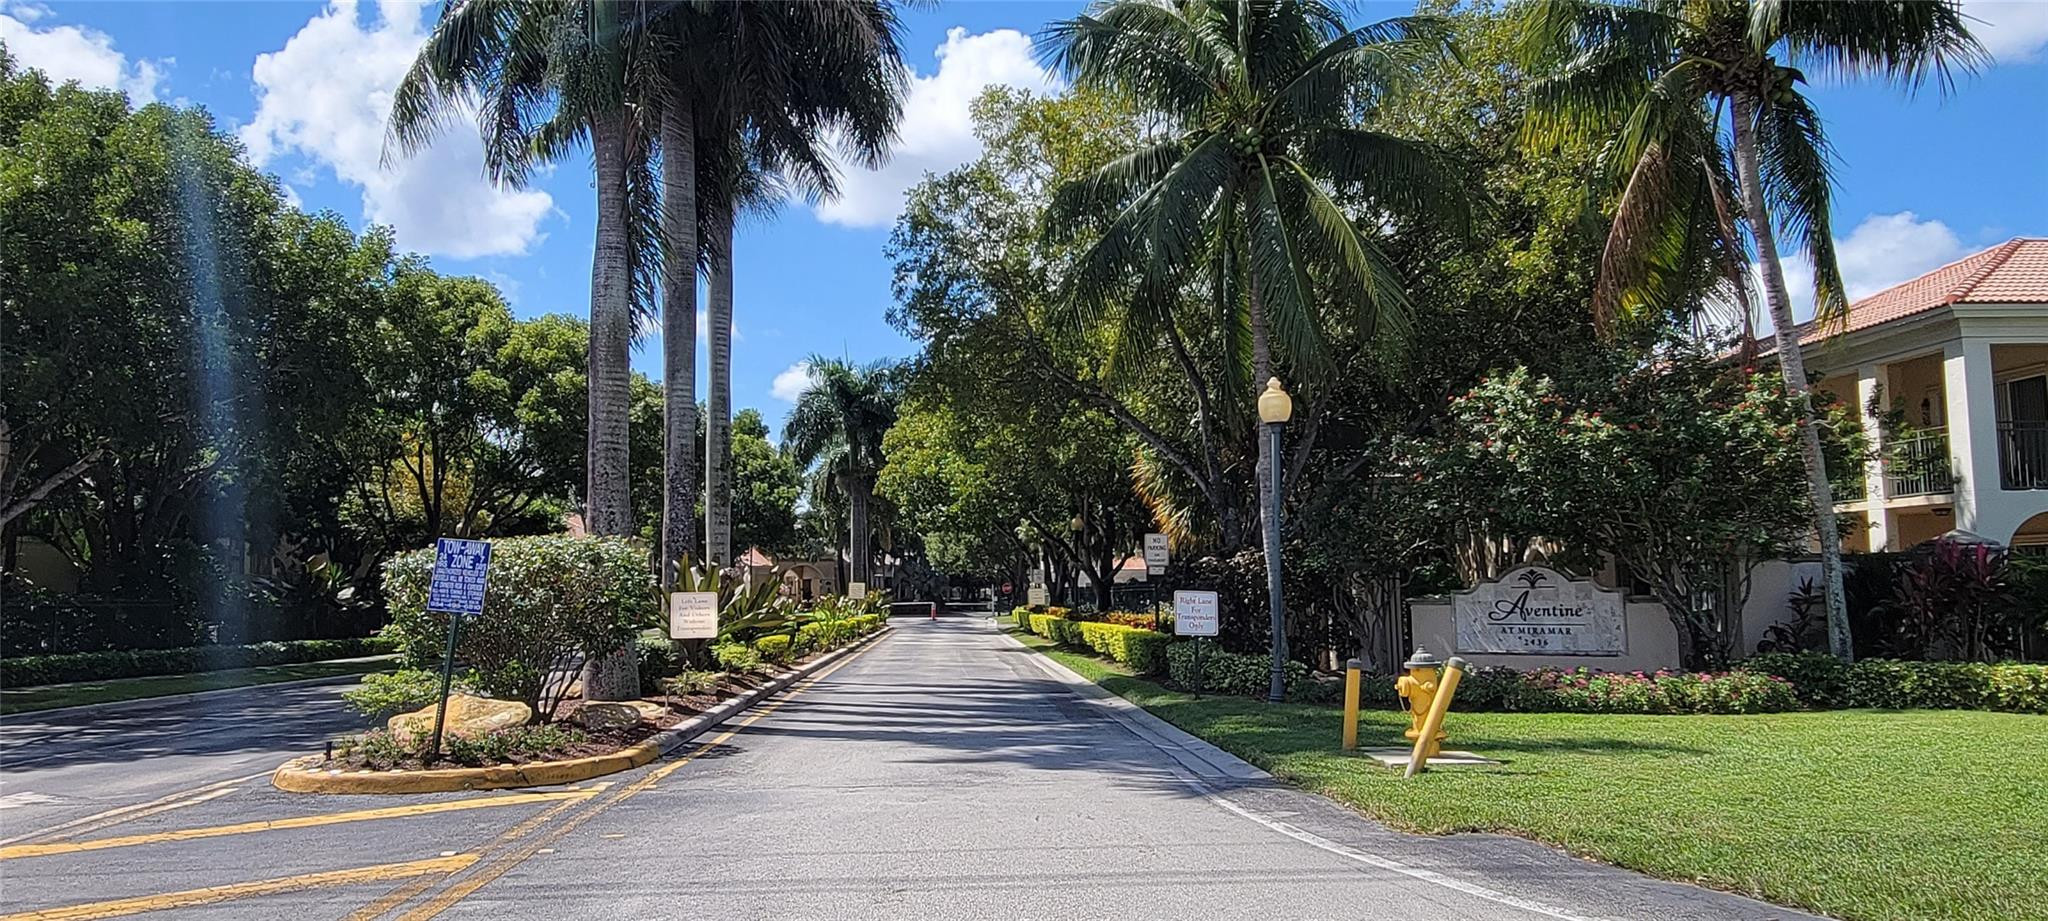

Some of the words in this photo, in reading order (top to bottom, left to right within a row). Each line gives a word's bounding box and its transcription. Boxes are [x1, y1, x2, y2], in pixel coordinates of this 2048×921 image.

[444, 540, 486, 556] TOW-AWAY
[451, 554, 474, 569] ZONE
[1180, 596, 1196, 604] Right
[1488, 590, 1582, 622] Aventine
[1178, 613, 1216, 621] Transponders
[1189, 622, 1203, 630] Only
[1518, 627, 1572, 635] MIRAMAR
